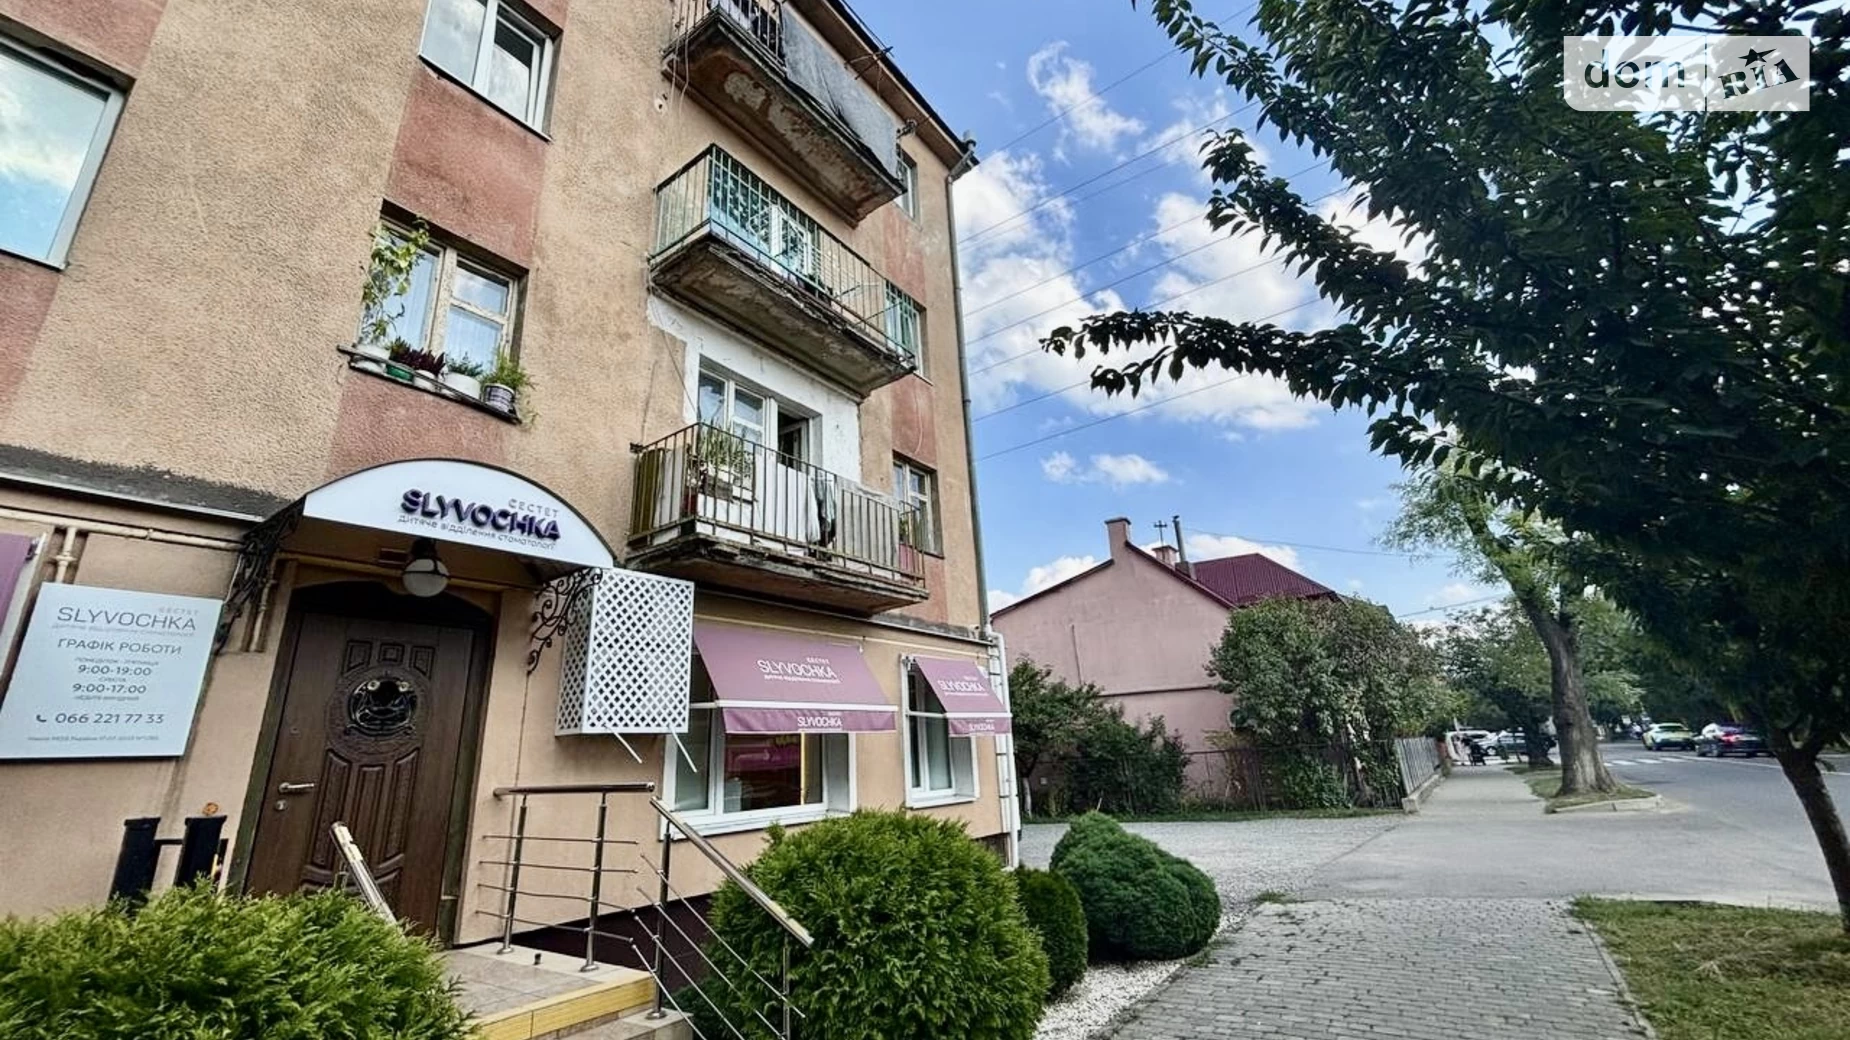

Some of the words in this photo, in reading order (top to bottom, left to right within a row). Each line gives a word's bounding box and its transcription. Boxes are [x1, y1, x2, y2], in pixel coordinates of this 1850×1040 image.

[401, 489, 561, 541] SLYVOCHKA
[57, 606, 196, 631] SLYVOCHKA
[58, 638, 115, 652] ГРАФІК
[119, 641, 182, 655] РОБОТИ
[757, 659, 838, 679] SLYVOCHKA
[937, 680, 986, 692] SLYVOCHKA
[55, 712, 89, 724] 066
[93, 713, 120, 724] 221
[125, 713, 143, 724] 77
[145, 713, 165, 724] 33
[797, 716, 843, 727] SLYVOCHKA
